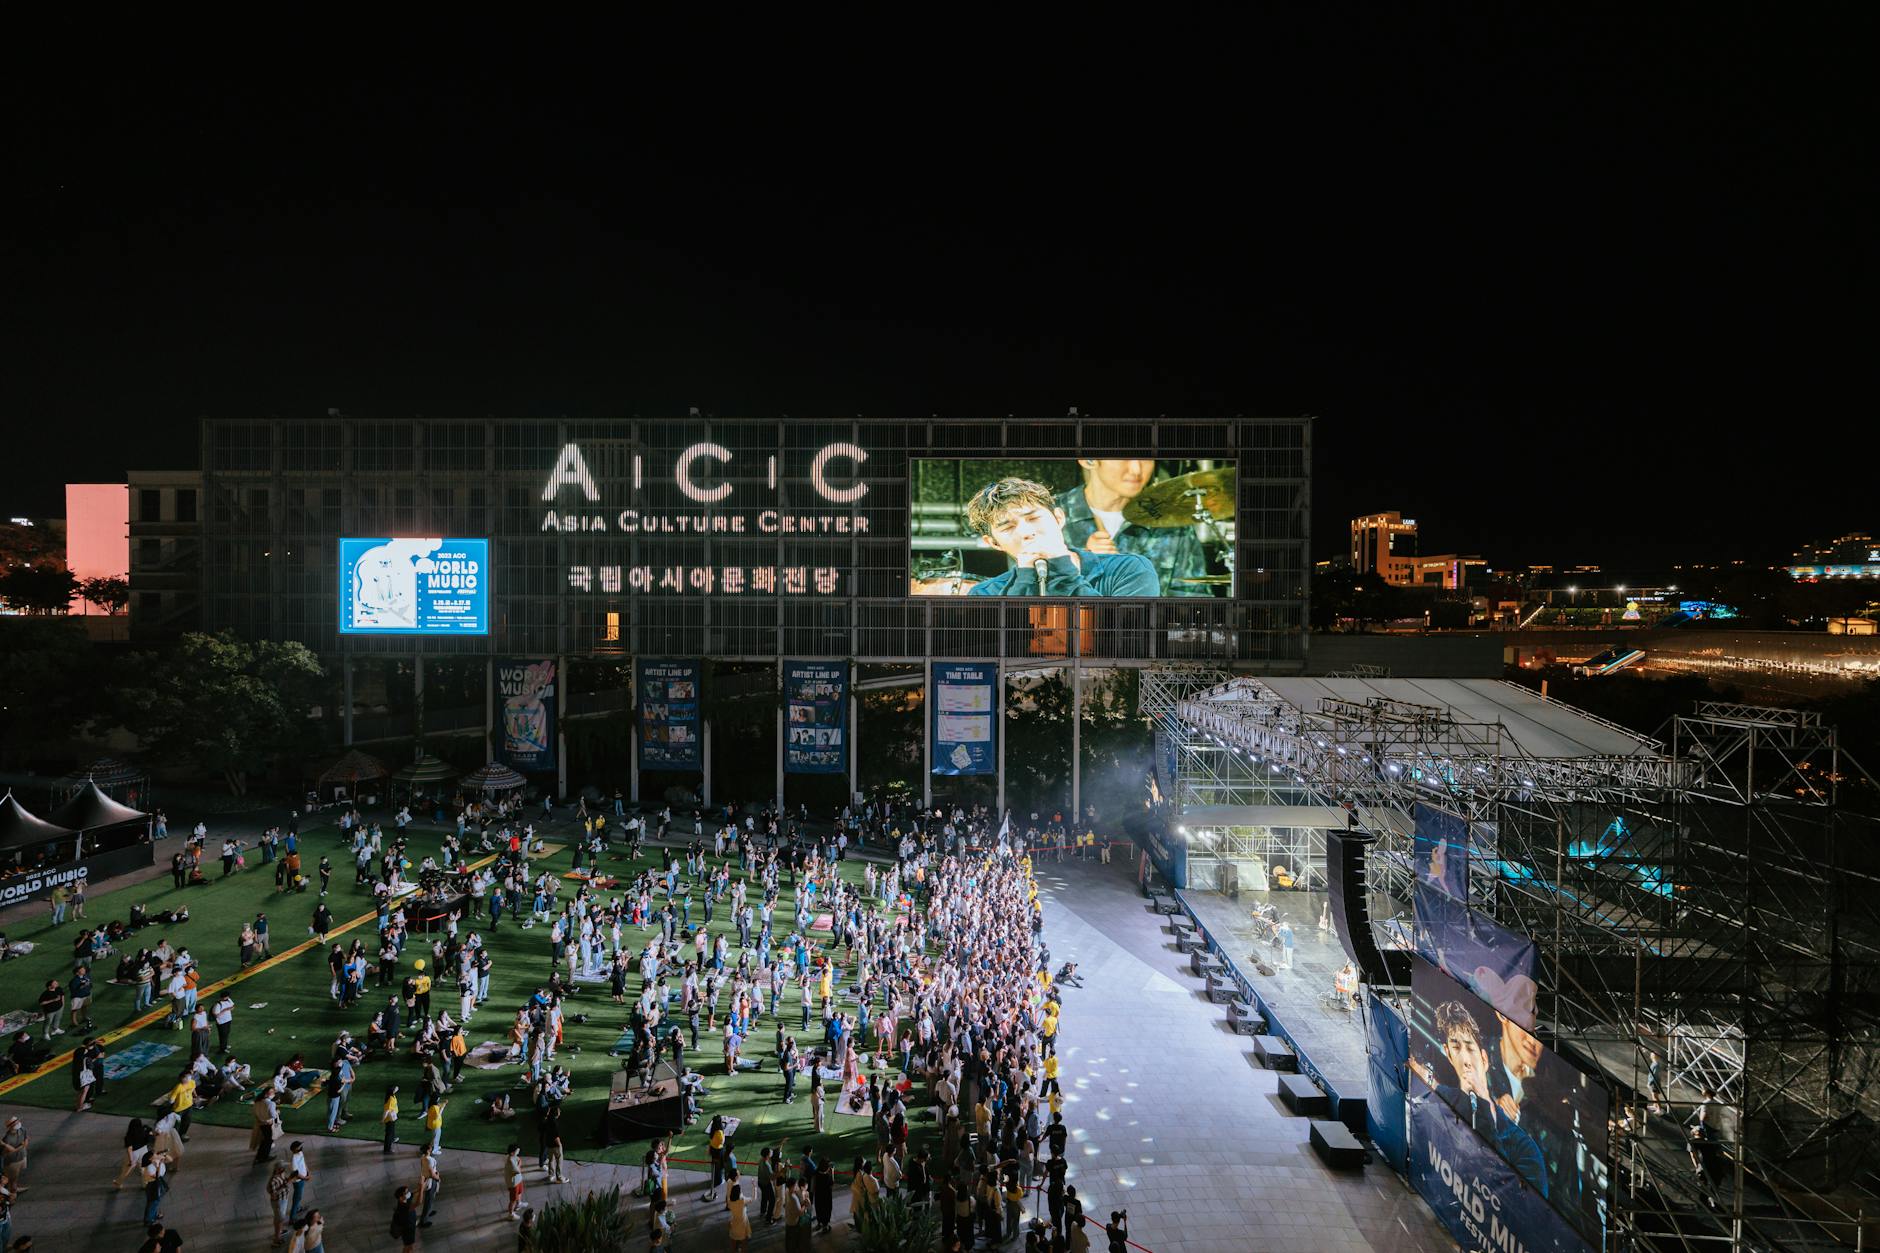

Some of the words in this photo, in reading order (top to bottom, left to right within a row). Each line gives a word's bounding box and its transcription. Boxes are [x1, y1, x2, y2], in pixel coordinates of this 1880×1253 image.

[428, 574, 477, 588] MUSIC
[568, 565, 839, 594] 국립아시아문화전당
[644, 668, 667, 676] ARTIST
[667, 668, 682, 677] LINE
[683, 669, 692, 677] UP
[792, 670, 814, 678] ARTIST
[815, 670, 830, 679] LINE
[830, 670, 840, 679] UP
[945, 671, 962, 680] TIME
[962, 671, 984, 680] TABLE
[26, 872, 42, 881] 2022
[42, 868, 57, 877] ACC
[46, 866, 89, 888] MUSIC
[1428, 1140, 1486, 1223] WORLD
[1472, 1175, 1502, 1211] ACC
